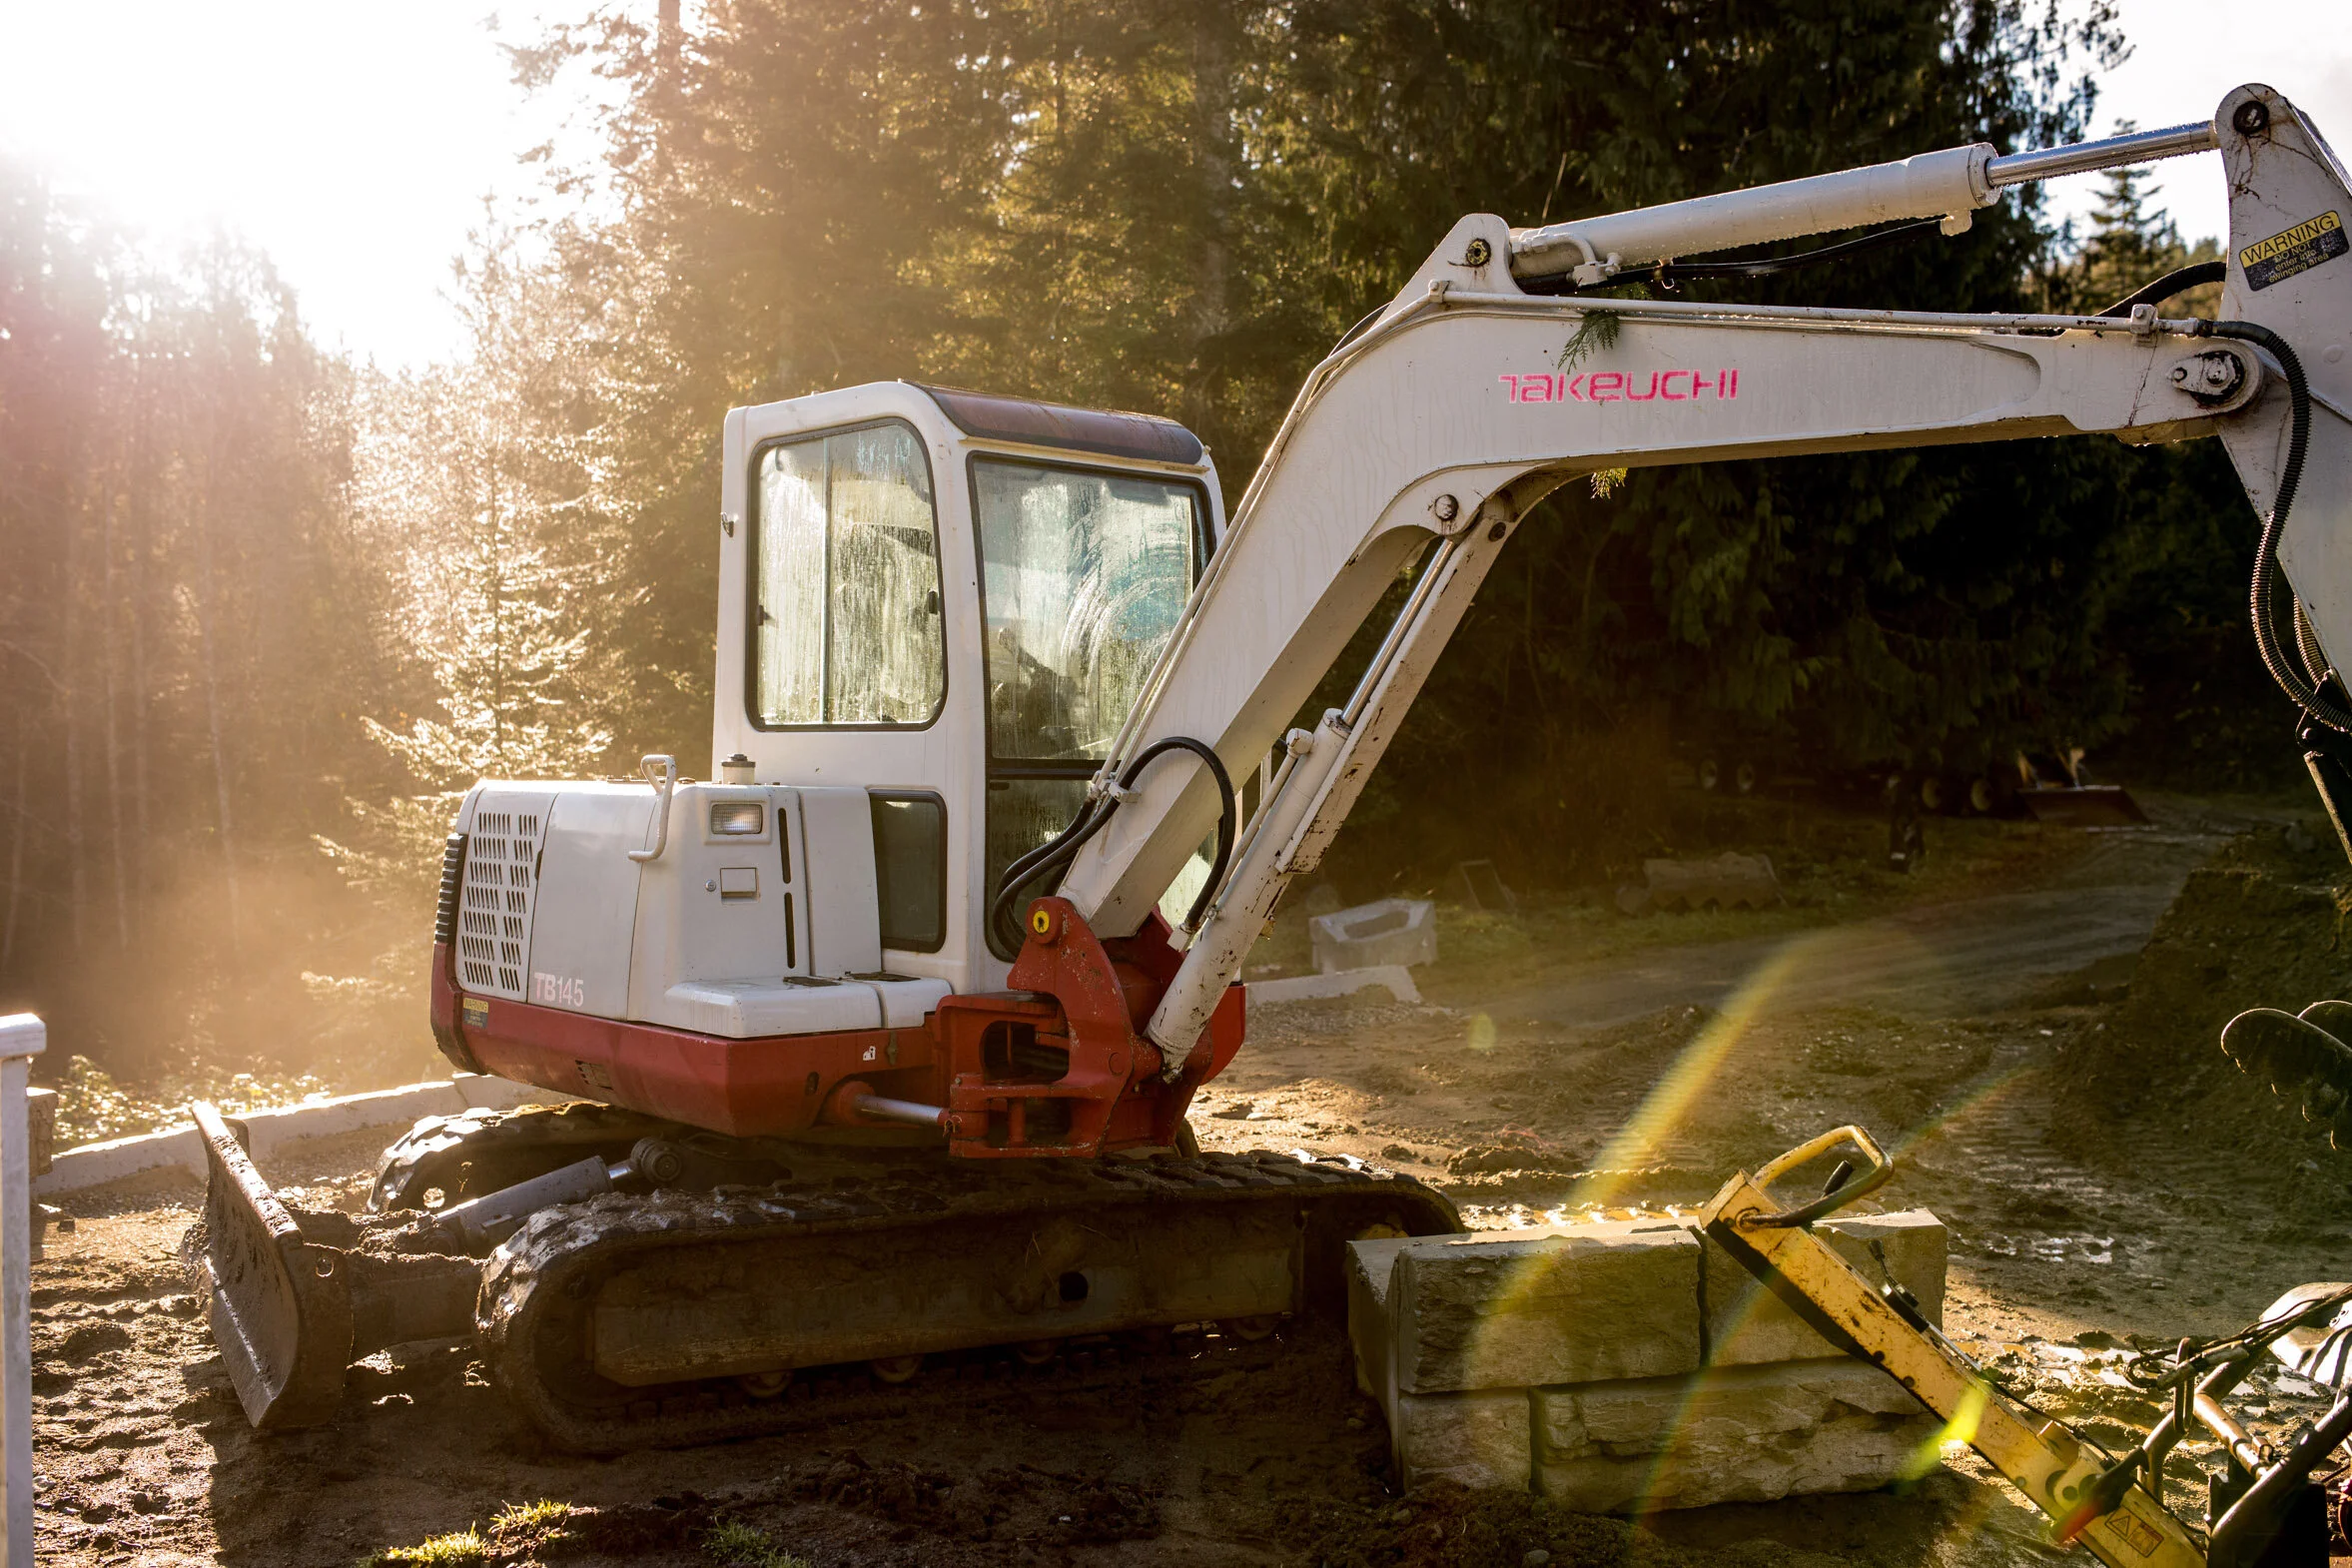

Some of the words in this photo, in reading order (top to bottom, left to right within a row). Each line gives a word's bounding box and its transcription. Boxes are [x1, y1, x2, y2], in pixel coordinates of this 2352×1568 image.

[2244, 215, 2335, 264] WARNING
[2274, 251, 2290, 263] DO
[2290, 241, 2313, 257] NOT
[2268, 262, 2308, 283] swinging
[2308, 252, 2329, 267] area
[2275, 257, 2298, 271] enter
[2299, 249, 2317, 262] into
[534, 972, 584, 1008] TB145
